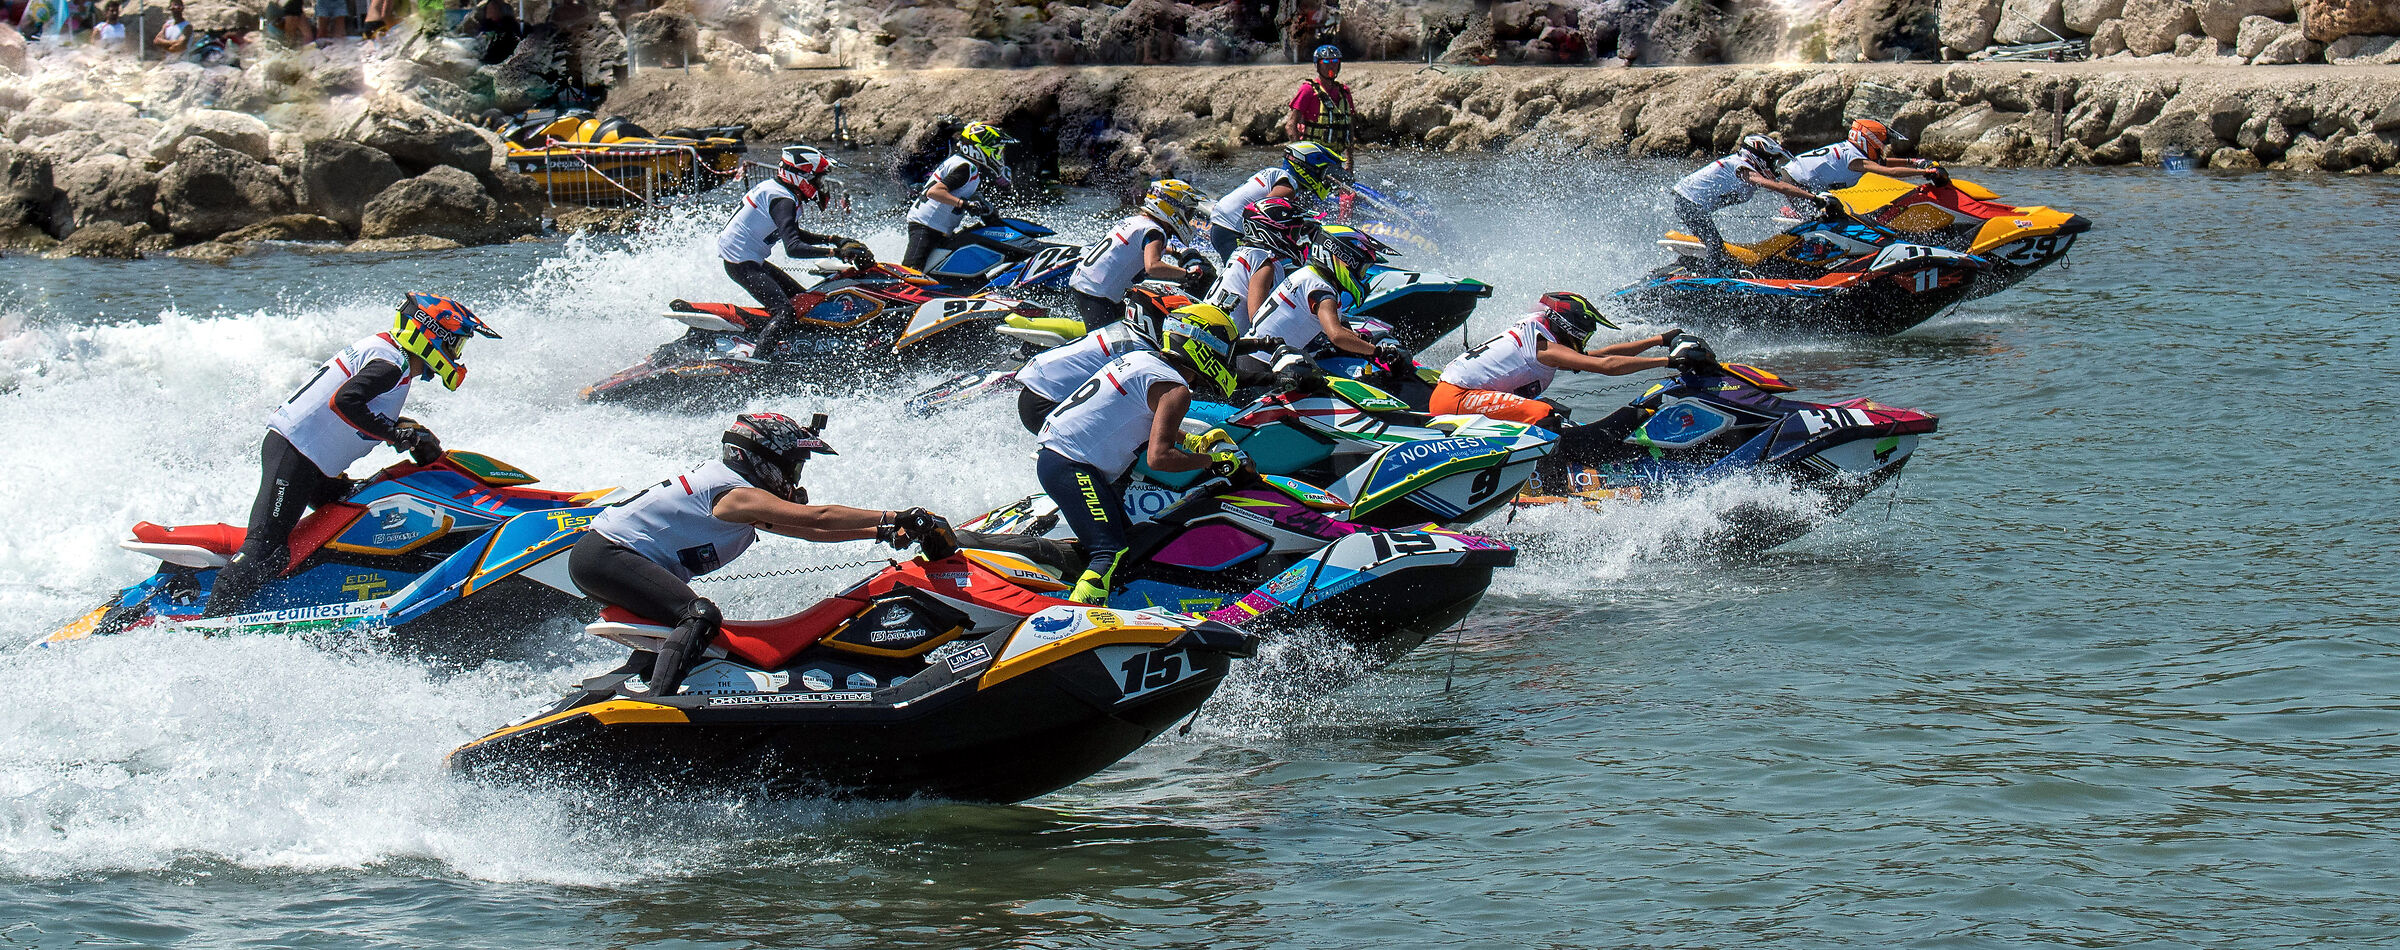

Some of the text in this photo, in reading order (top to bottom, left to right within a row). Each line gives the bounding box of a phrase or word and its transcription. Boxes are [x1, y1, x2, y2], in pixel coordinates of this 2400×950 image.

[1905, 246, 1933, 258] 11
[2006, 236, 2058, 259] 29
[1403, 272, 1420, 285] 7
[1913, 267, 1938, 293] 11
[943, 300, 986, 318] 97
[1399, 437, 1488, 465] NOVATEST
[1075, 472, 1108, 523] JETPILOT
[1467, 469, 1502, 506] 9
[272, 486, 285, 518] TRIBORD
[346, 573, 385, 584] EDIL
[950, 653, 973, 665] UIM
[1120, 649, 1184, 695] 15
[768, 694, 820, 703] MITCHELL
